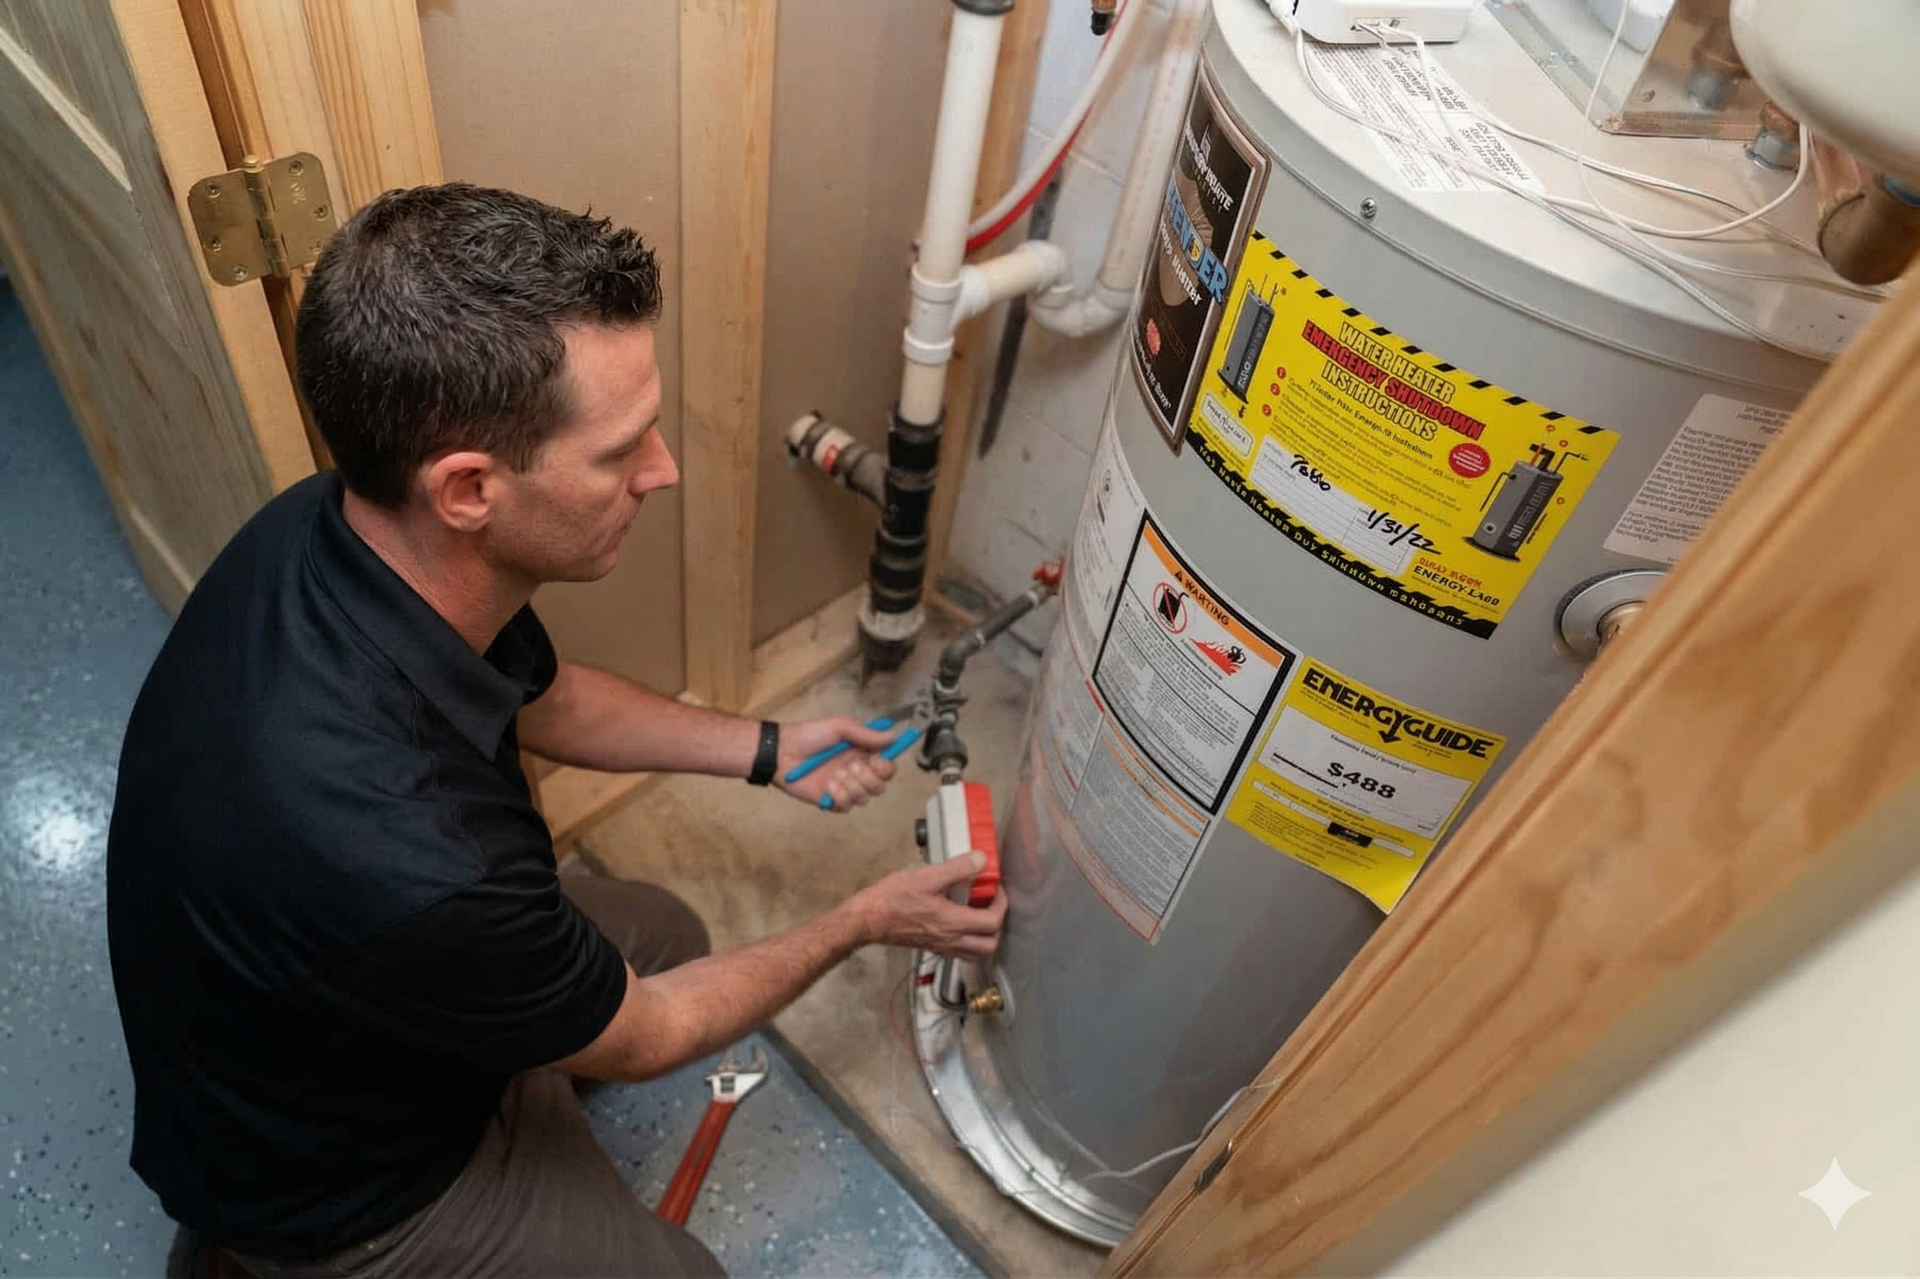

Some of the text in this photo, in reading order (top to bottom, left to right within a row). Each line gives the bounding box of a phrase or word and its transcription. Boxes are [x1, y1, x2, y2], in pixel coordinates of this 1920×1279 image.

[1339, 321, 1455, 404] WATER HEATER
[1321, 360, 1438, 441] INSTRUCTIONS
[1385, 378, 1486, 441] SHUTDOWN
[1367, 509, 1442, 555] 1/31/22
[1302, 667, 1494, 759] ENERGYGUIDE
[1327, 762, 1396, 799] $488
